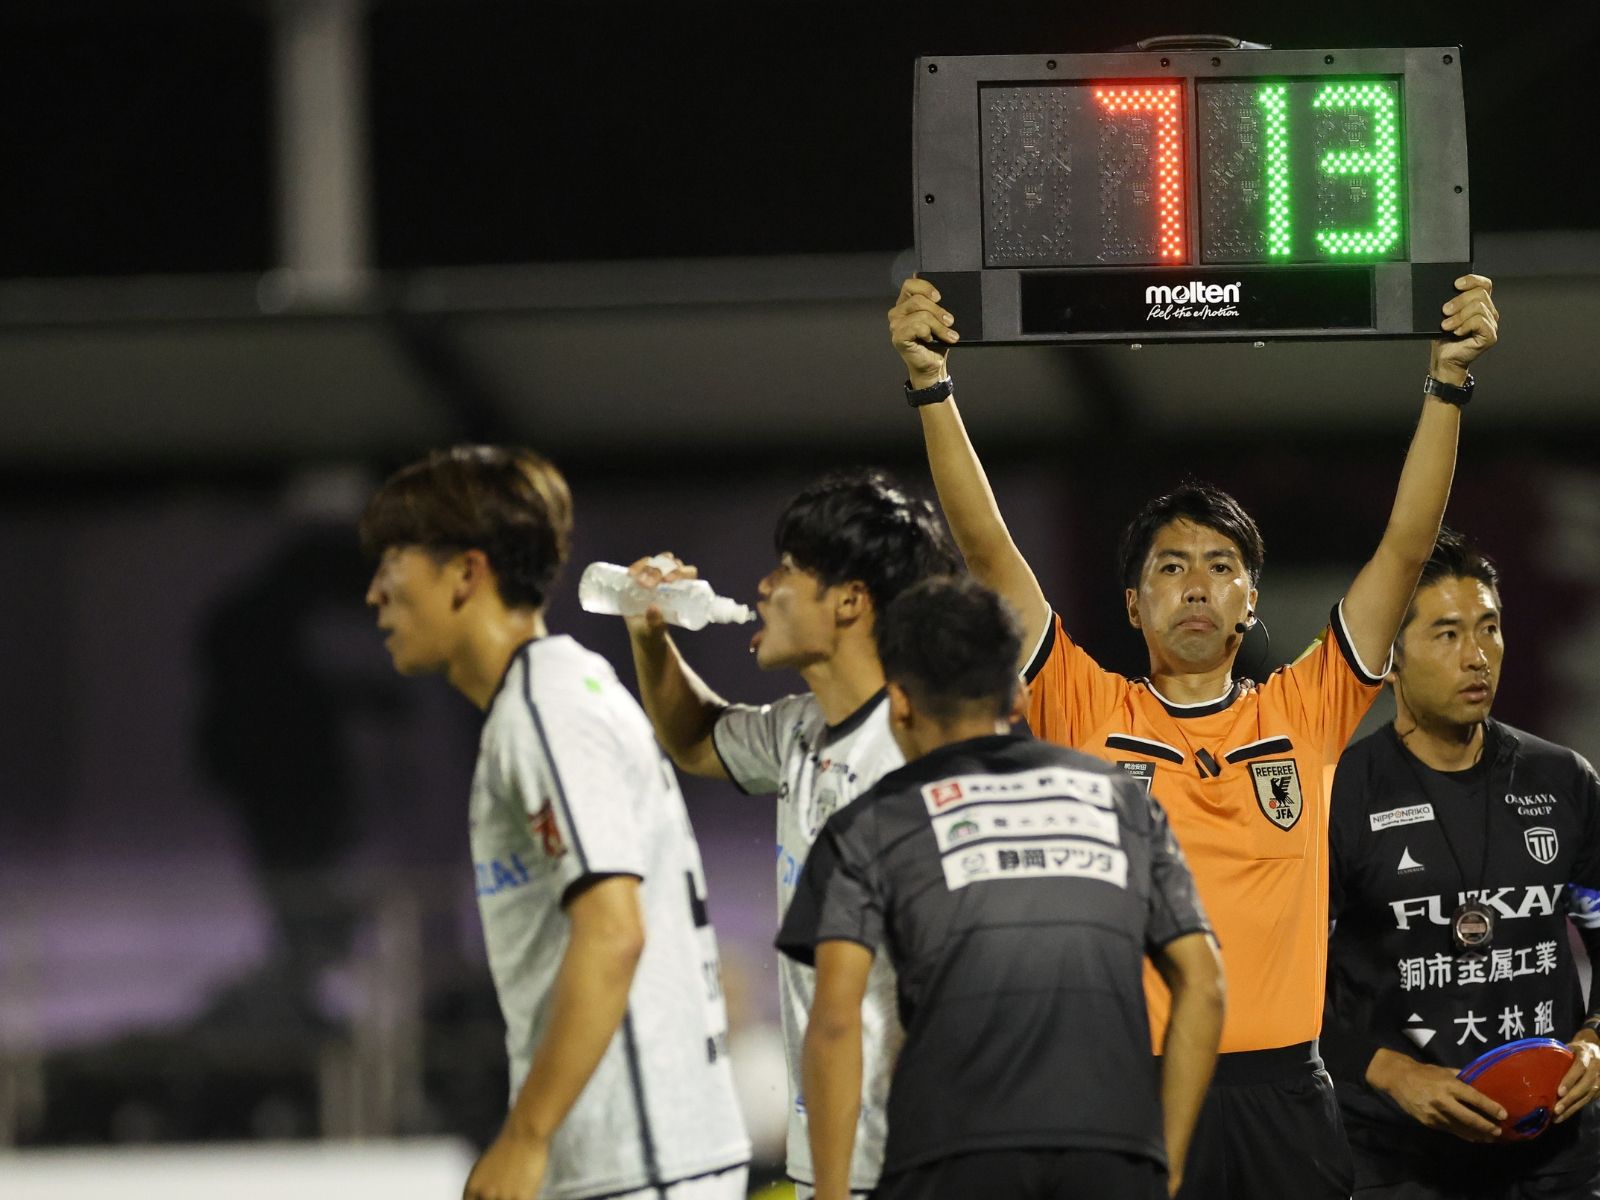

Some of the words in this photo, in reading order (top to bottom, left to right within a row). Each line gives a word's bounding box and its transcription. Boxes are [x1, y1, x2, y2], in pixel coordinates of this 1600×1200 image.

[1094, 87, 1181, 258] 7
[1258, 85, 1400, 257] 13
[1145, 281, 1241, 304] molten
[1172, 306, 1193, 319] the
[1255, 765, 1294, 777] REFEREE
[1276, 808, 1294, 820] JFA
[998, 848, 1113, 873] 静岡マツダ
[1453, 999, 1556, 1046] 大林組
